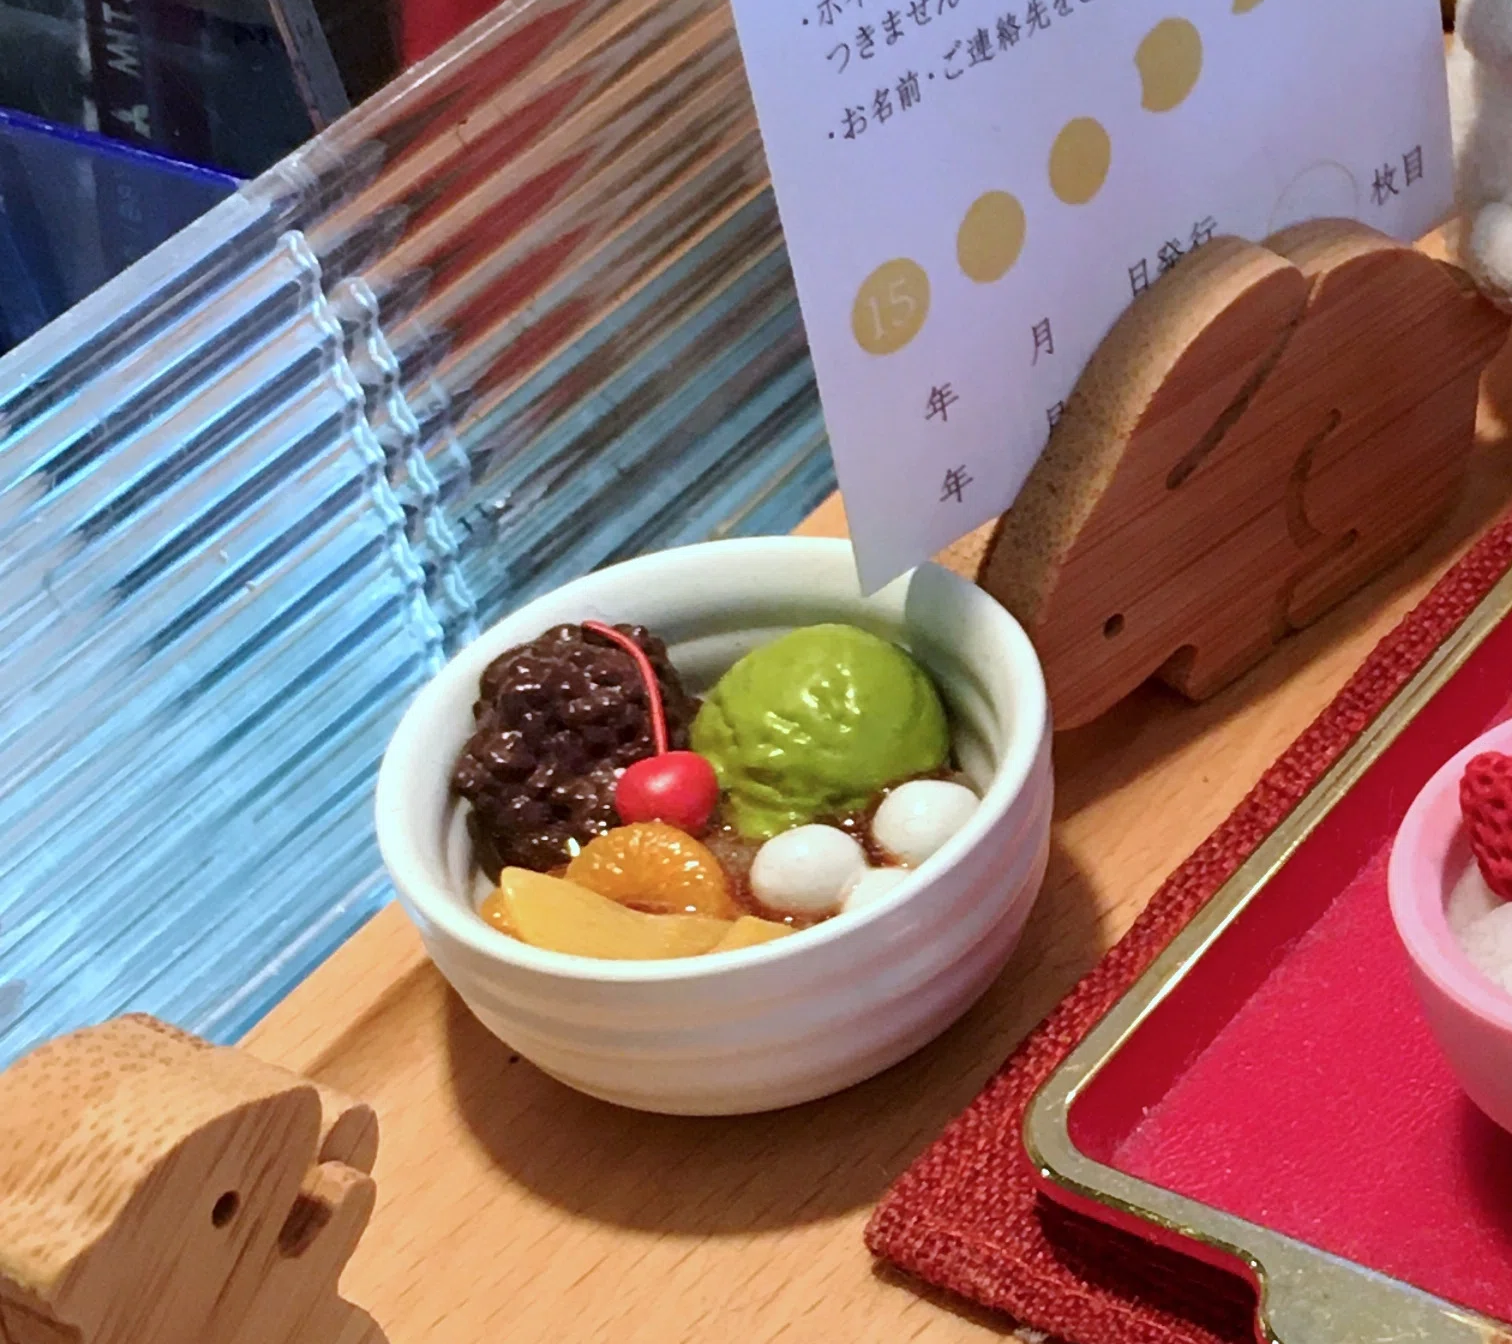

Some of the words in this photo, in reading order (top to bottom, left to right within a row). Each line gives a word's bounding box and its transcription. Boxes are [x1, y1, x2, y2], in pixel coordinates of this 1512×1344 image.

[866, 278, 916, 341] 15
[925, 382, 960, 423] 年
[1031, 317, 1055, 367] 月
[1371, 145, 1423, 205] 枚目
[939, 464, 974, 503] 年
